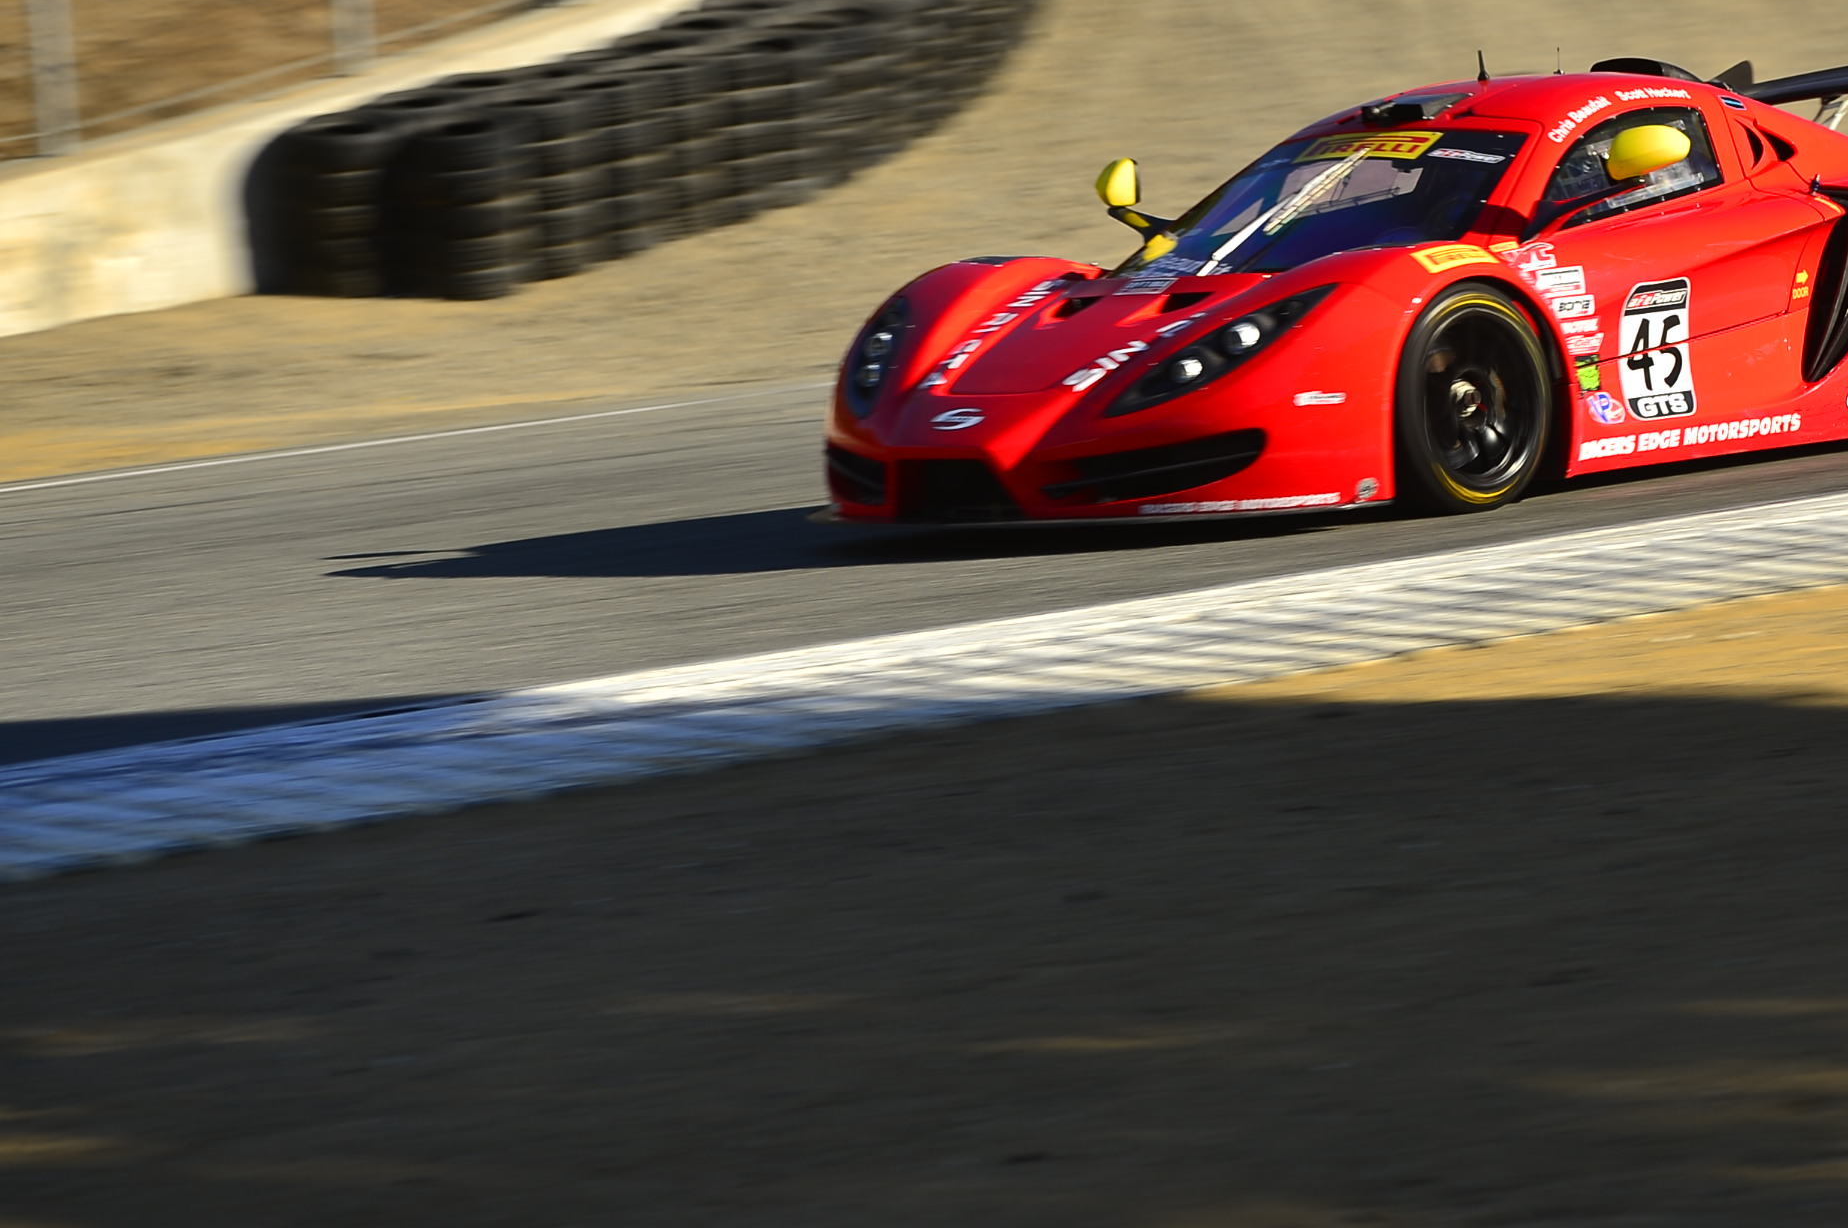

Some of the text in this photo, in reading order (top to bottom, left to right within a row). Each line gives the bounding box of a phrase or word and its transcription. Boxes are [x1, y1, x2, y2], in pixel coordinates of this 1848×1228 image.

[1547, 118, 1577, 144] Chris
[1303, 135, 1430, 159] PIRELLI
[1792, 286, 1809, 300] DOOR
[1626, 313, 1683, 392] 45
[1636, 392, 1689, 418] GTS
[1636, 428, 1682, 453] EDGE
[1683, 413, 1802, 446] MOTORSPORTS
